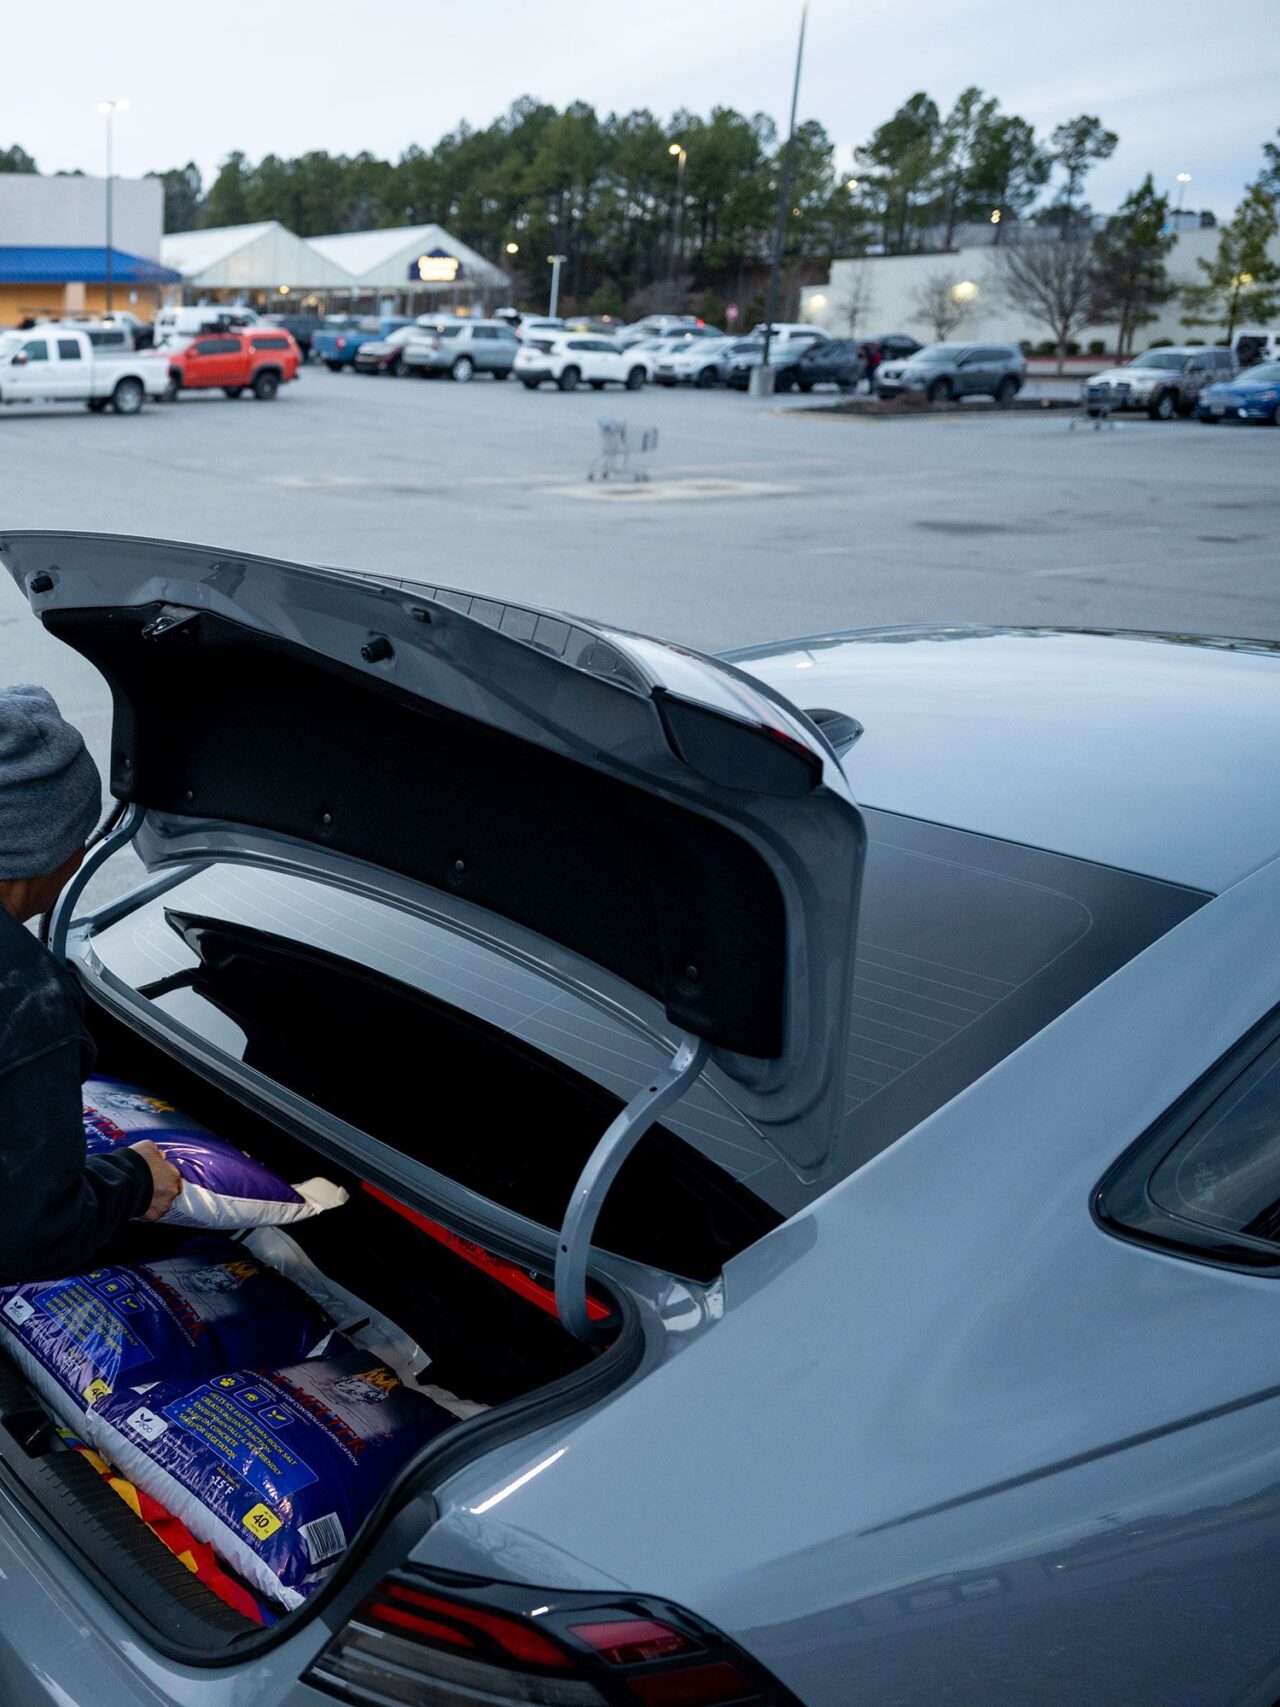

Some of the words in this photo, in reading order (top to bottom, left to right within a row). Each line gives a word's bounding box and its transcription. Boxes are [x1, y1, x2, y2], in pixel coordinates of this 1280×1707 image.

[265, 1437, 285, 1453] ROCK
[280, 1452, 298, 1466] SALT
[211, 1475, 234, 1495] -15°F
[253, 1514, 270, 1528] 40
